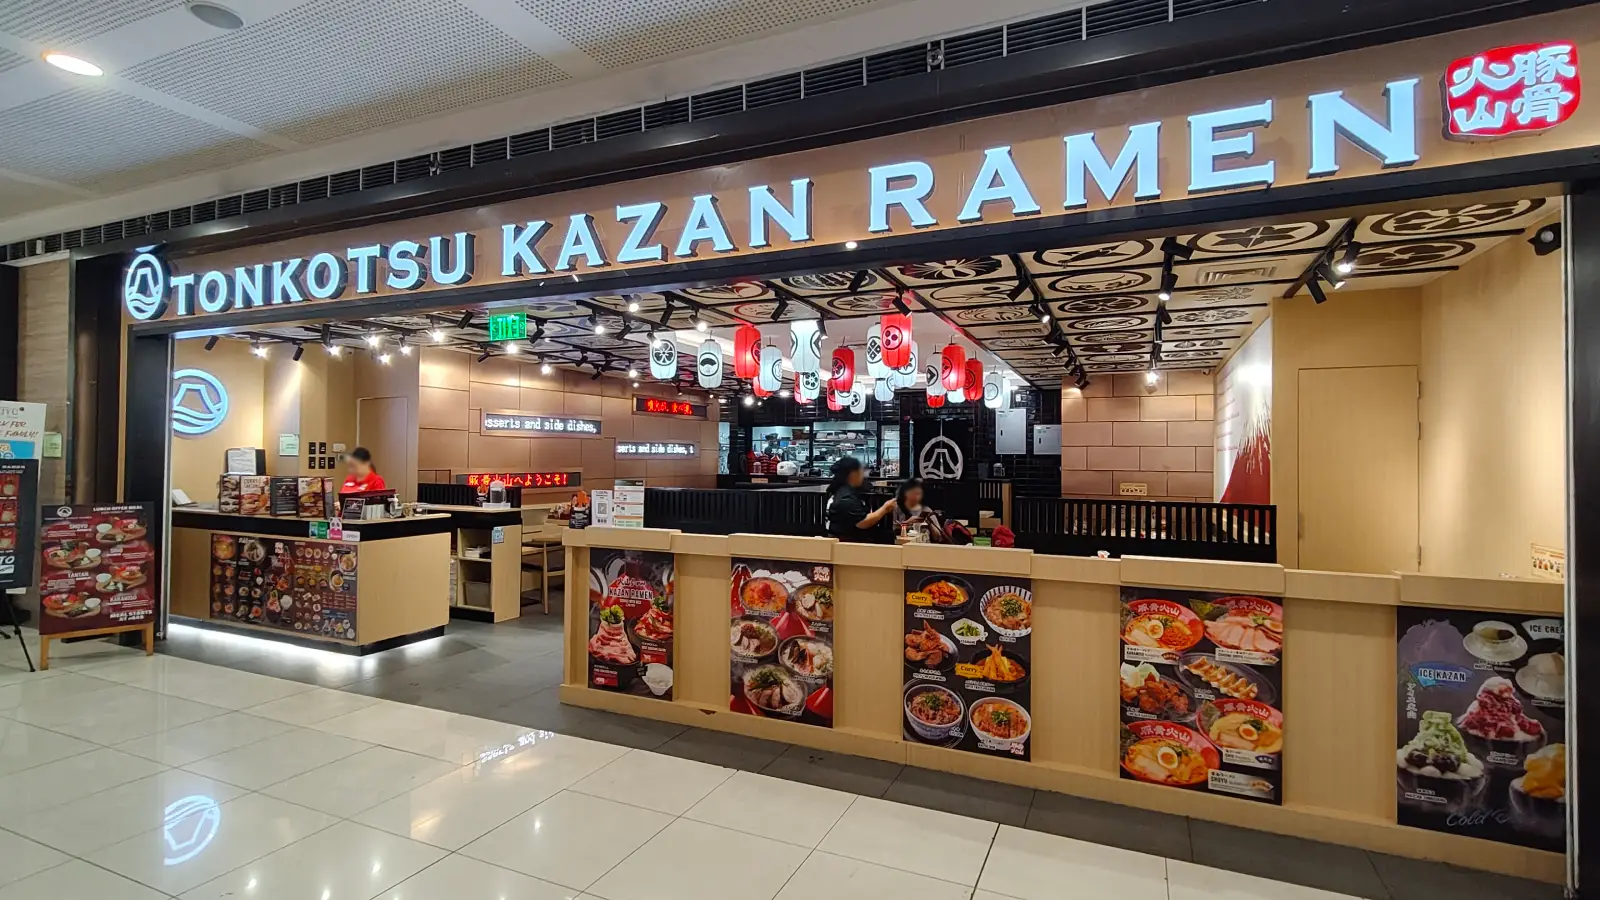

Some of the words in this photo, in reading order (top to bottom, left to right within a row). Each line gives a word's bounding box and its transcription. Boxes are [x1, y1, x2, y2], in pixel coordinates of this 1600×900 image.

[170, 232, 474, 316] TONKOTSU
[501, 178, 812, 277] KAZAN
[868, 77, 1420, 233] RAMEN
[524, 419, 541, 430] and
[544, 418, 564, 431] side
[567, 419, 597, 434] dishes,
[638, 444, 650, 453] and
[651, 444, 665, 454] side
[609, 587, 630, 598] KAZAN
[630, 589, 654, 600] RAMEN
[911, 594, 927, 602] Curry
[1529, 624, 1542, 633] ICE
[960, 665, 978, 674] Curry
[1419, 669, 1433, 679] ICE
[1436, 670, 1466, 682] KAZAN
[1446, 809, 1492, 827] Cold
